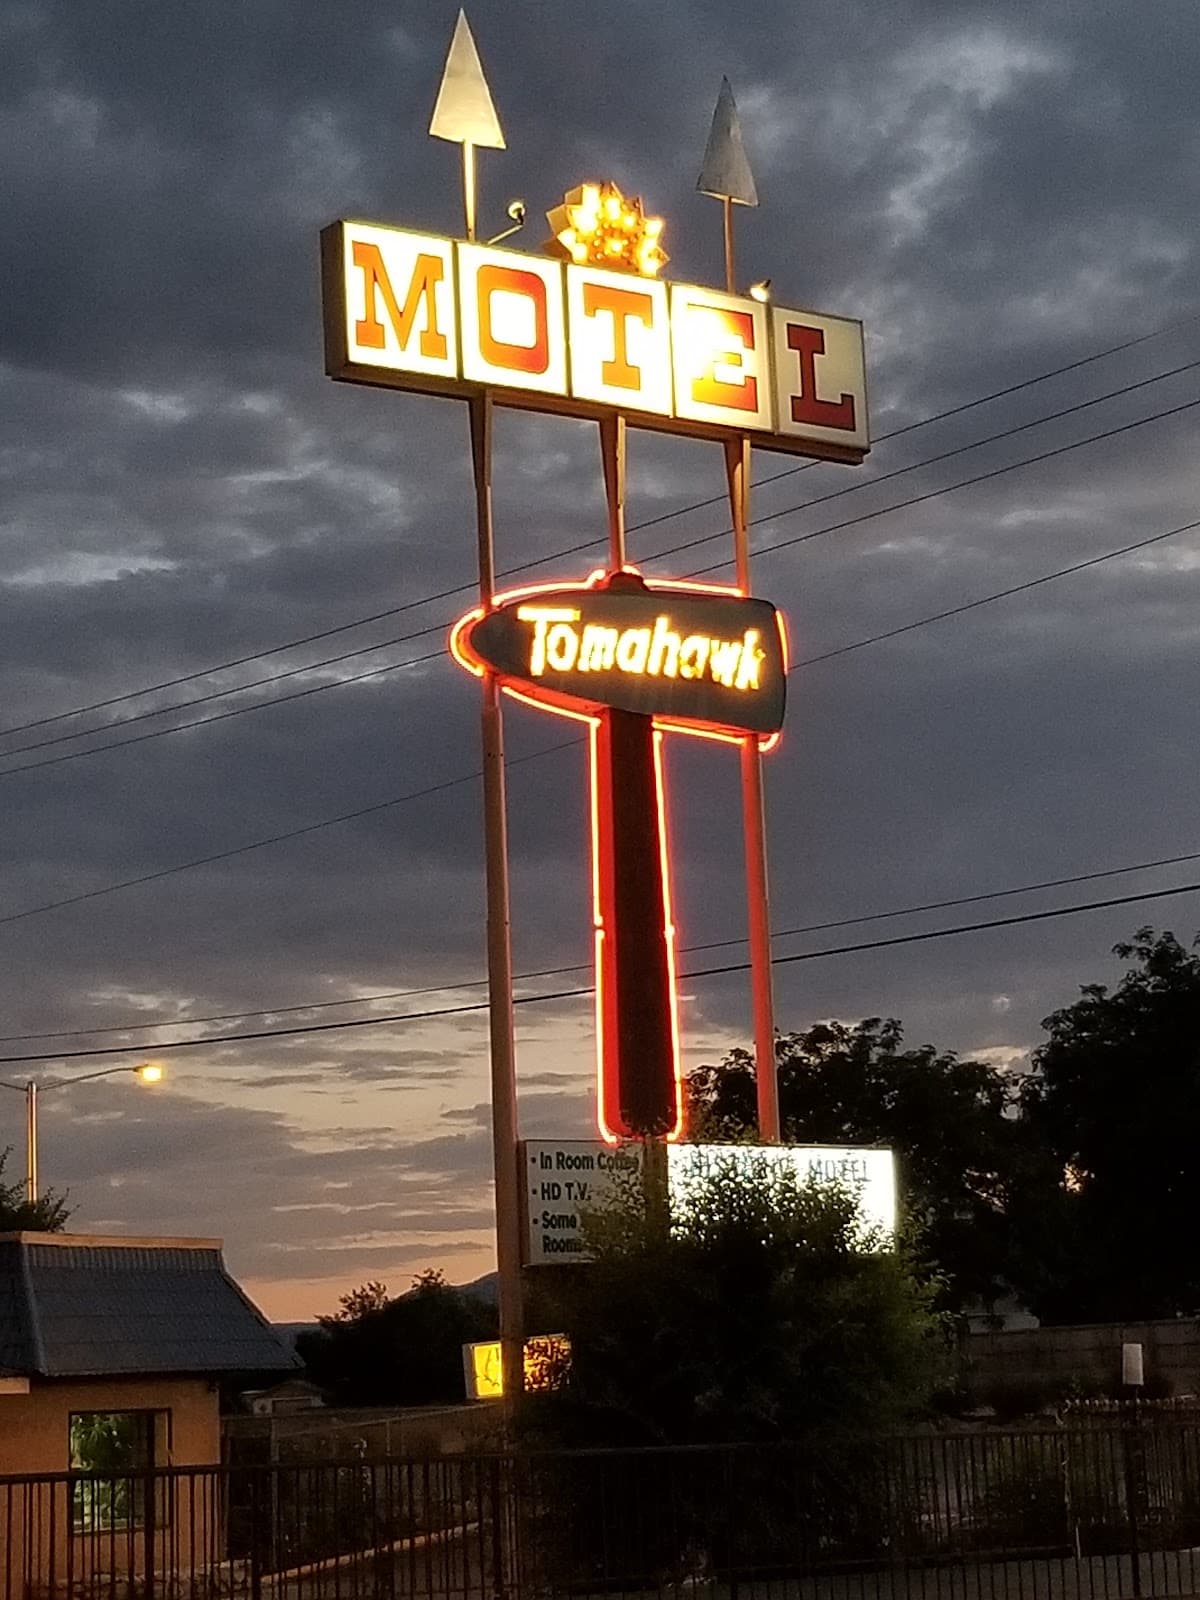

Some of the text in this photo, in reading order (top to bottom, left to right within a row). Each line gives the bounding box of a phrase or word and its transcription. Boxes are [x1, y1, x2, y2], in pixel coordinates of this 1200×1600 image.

[351, 240, 856, 433] MOTEL
[516, 605, 767, 691] Tomahawk
[540, 1151, 553, 1169] In
[556, 1151, 594, 1170] Room
[541, 1182, 561, 1200] HD
[542, 1210, 577, 1229] Some
